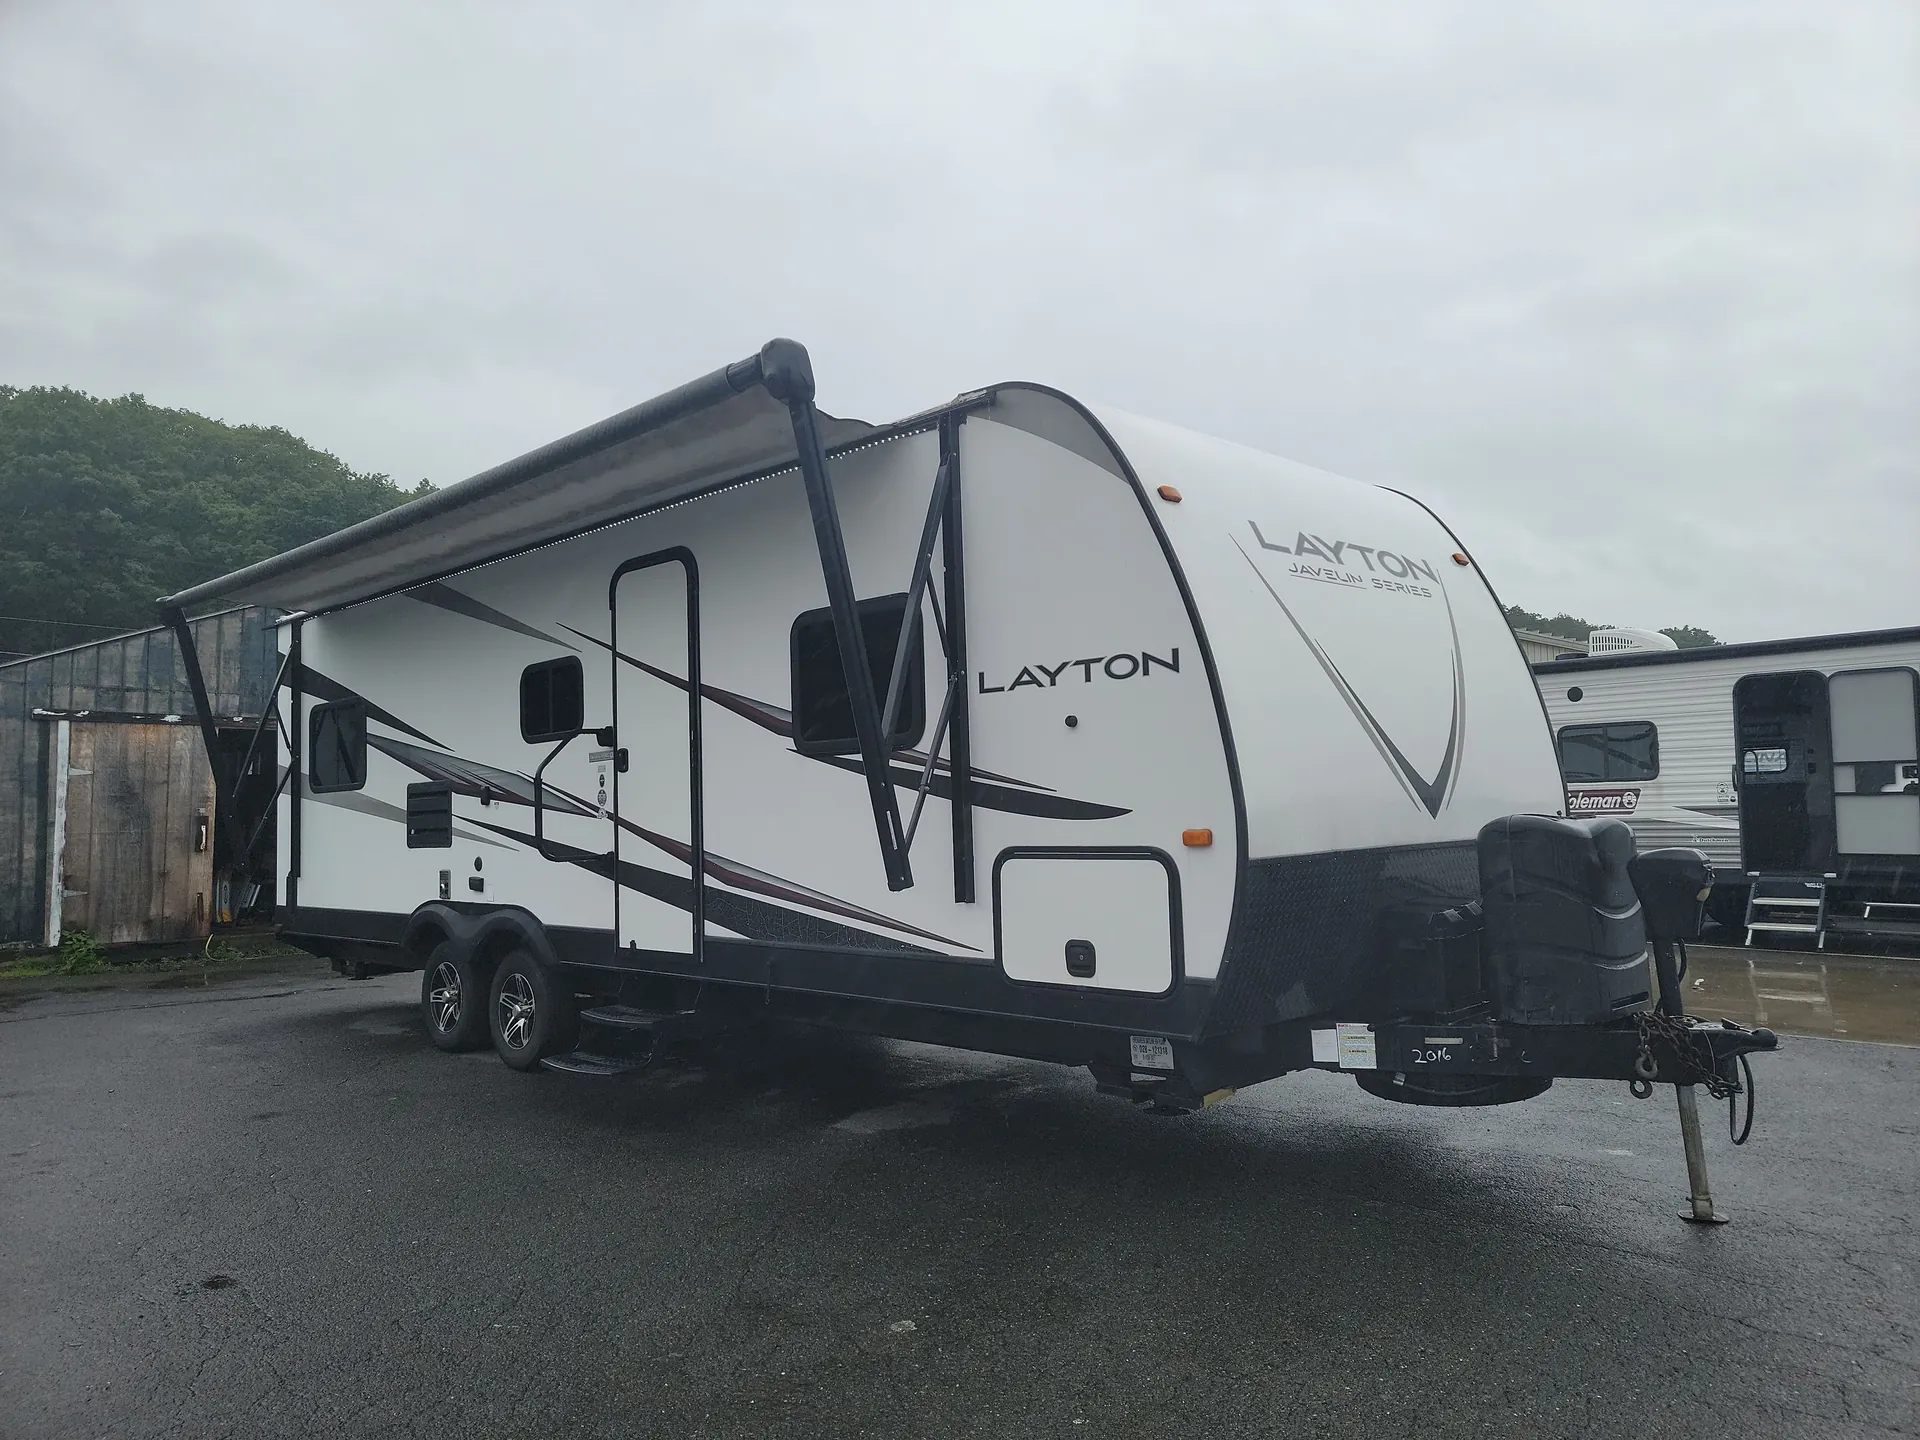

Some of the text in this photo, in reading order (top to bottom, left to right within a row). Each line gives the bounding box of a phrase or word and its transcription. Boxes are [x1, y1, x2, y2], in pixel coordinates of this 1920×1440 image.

[1247, 519, 1440, 585] LAYTON
[1288, 562, 1432, 598] JAVELIN SERIES
[978, 647, 1180, 694] LAYTON
[1568, 791, 1622, 809] oleman
[1411, 1047, 1452, 1063] 2016
